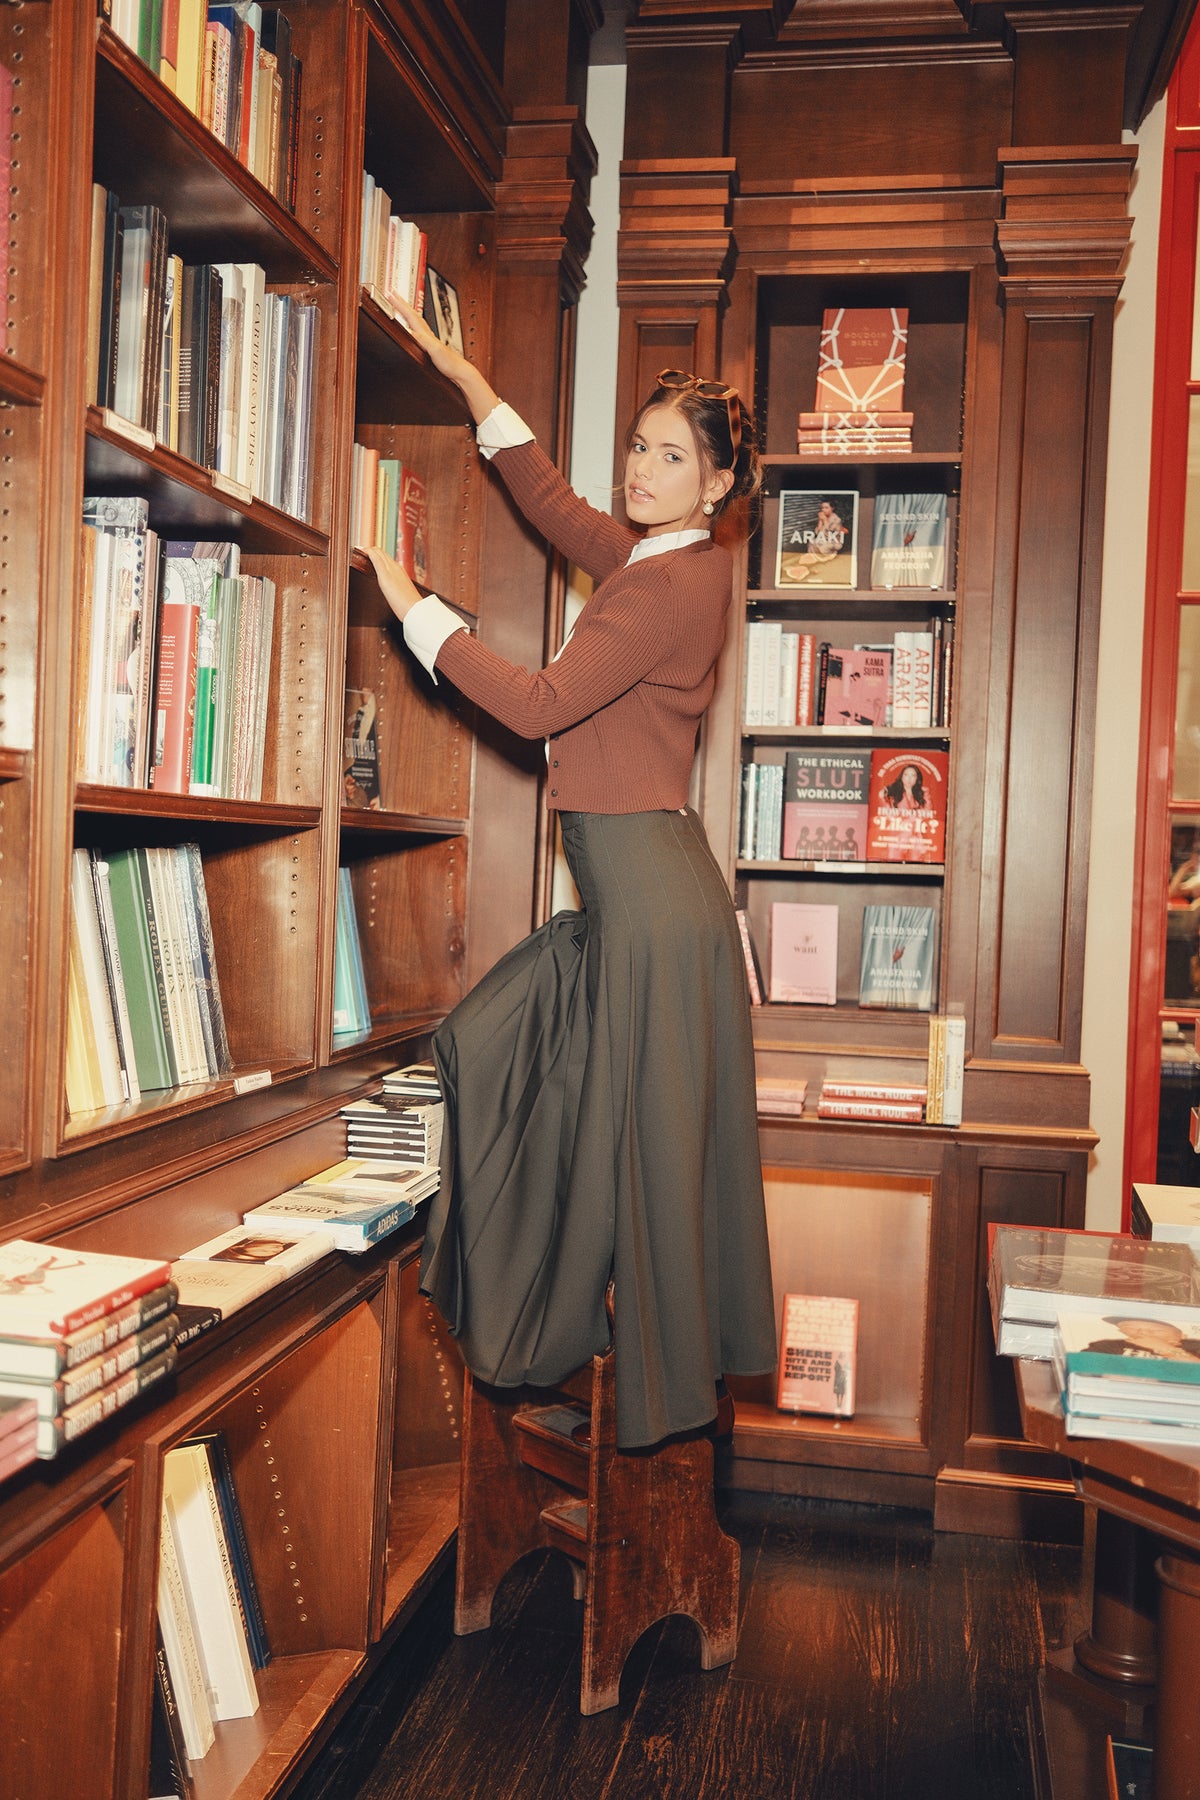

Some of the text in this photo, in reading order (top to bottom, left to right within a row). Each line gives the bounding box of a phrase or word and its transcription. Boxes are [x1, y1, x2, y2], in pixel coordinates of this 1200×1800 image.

[252, 303, 261, 383] CARTIER
[248, 402, 257, 466] MYTHS
[879, 512, 940, 522] SECOND SKIN
[789, 530, 845, 545] ARAKI
[864, 657, 884, 667] KAMA
[863, 667, 884, 677] SUTRA
[896, 647, 911, 710] ARAKI
[914, 647, 930, 710] ARAKI
[797, 757, 818, 769] THE
[820, 759, 864, 771] ETHICAL
[797, 768, 864, 788] SLUT
[797, 788, 862, 801] WORKBOOK
[873, 816, 912, 831] Like
[869, 926, 928, 936] SECOND SKIN
[794, 945, 817, 954] want
[113, 949, 122, 976] TANK
[162, 939, 176, 995] ROLEX
[148, 920, 162, 975] ROLEX
[158, 982, 171, 1037] GUIDE
[835, 1087, 912, 1100] THE MALE NUDE
[830, 1106, 908, 1118] THE MALE NUDE
[268, 1204, 347, 1215] ADIDAS
[376, 1210, 399, 1237] ADIDAS
[786, 1348, 832, 1359] SHERE
[786, 1357, 831, 1367] HITE AND
[808, 1365, 831, 1374] HITE
[785, 1372, 831, 1382] REPORT
[202, 1462, 237, 1608] THE SOUL OF JEWELLERY
[157, 1650, 174, 1716] PANERAI
